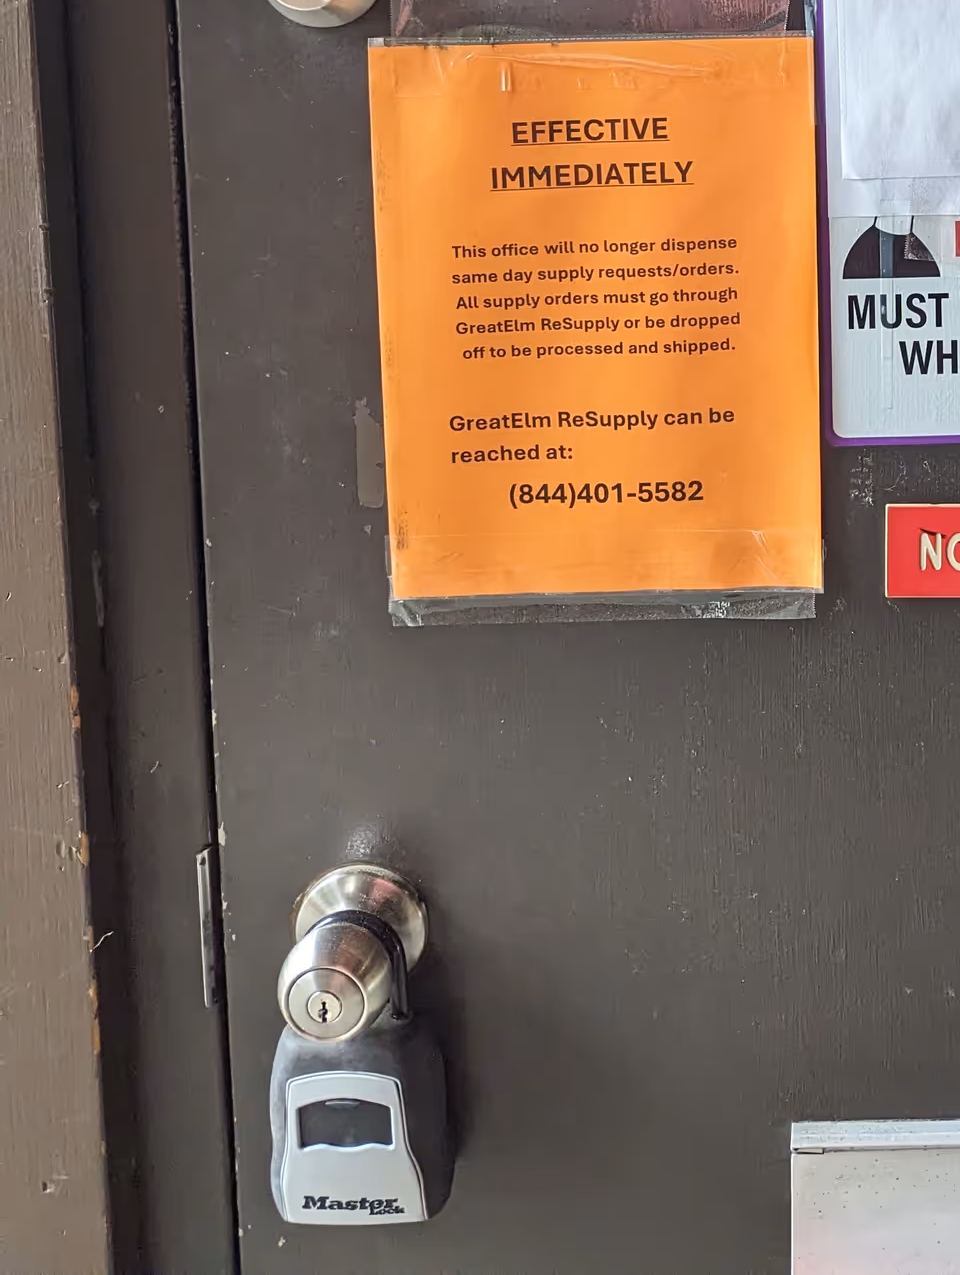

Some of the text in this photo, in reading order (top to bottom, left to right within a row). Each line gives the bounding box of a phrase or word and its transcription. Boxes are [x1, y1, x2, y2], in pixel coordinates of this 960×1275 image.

[511, 116, 668, 144] EFFECTIVE
[491, 160, 693, 189] IMMEDIATELY
[451, 238, 737, 258] This office will no longer dispense
[452, 262, 739, 284] same day supply requests/orders.
[456, 286, 737, 310] All supply orders must go through
[455, 311, 740, 335] GreatElm ReSupply or be dropped
[847, 292, 949, 330] MUST
[462, 337, 735, 359] off to be processed and shipped.
[449, 407, 734, 431] GreatElm ReSupply can be
[451, 443, 573, 464] reached at:
[509, 480, 704, 509] (844)401-5582
[302, 1195, 398, 1211] Master
